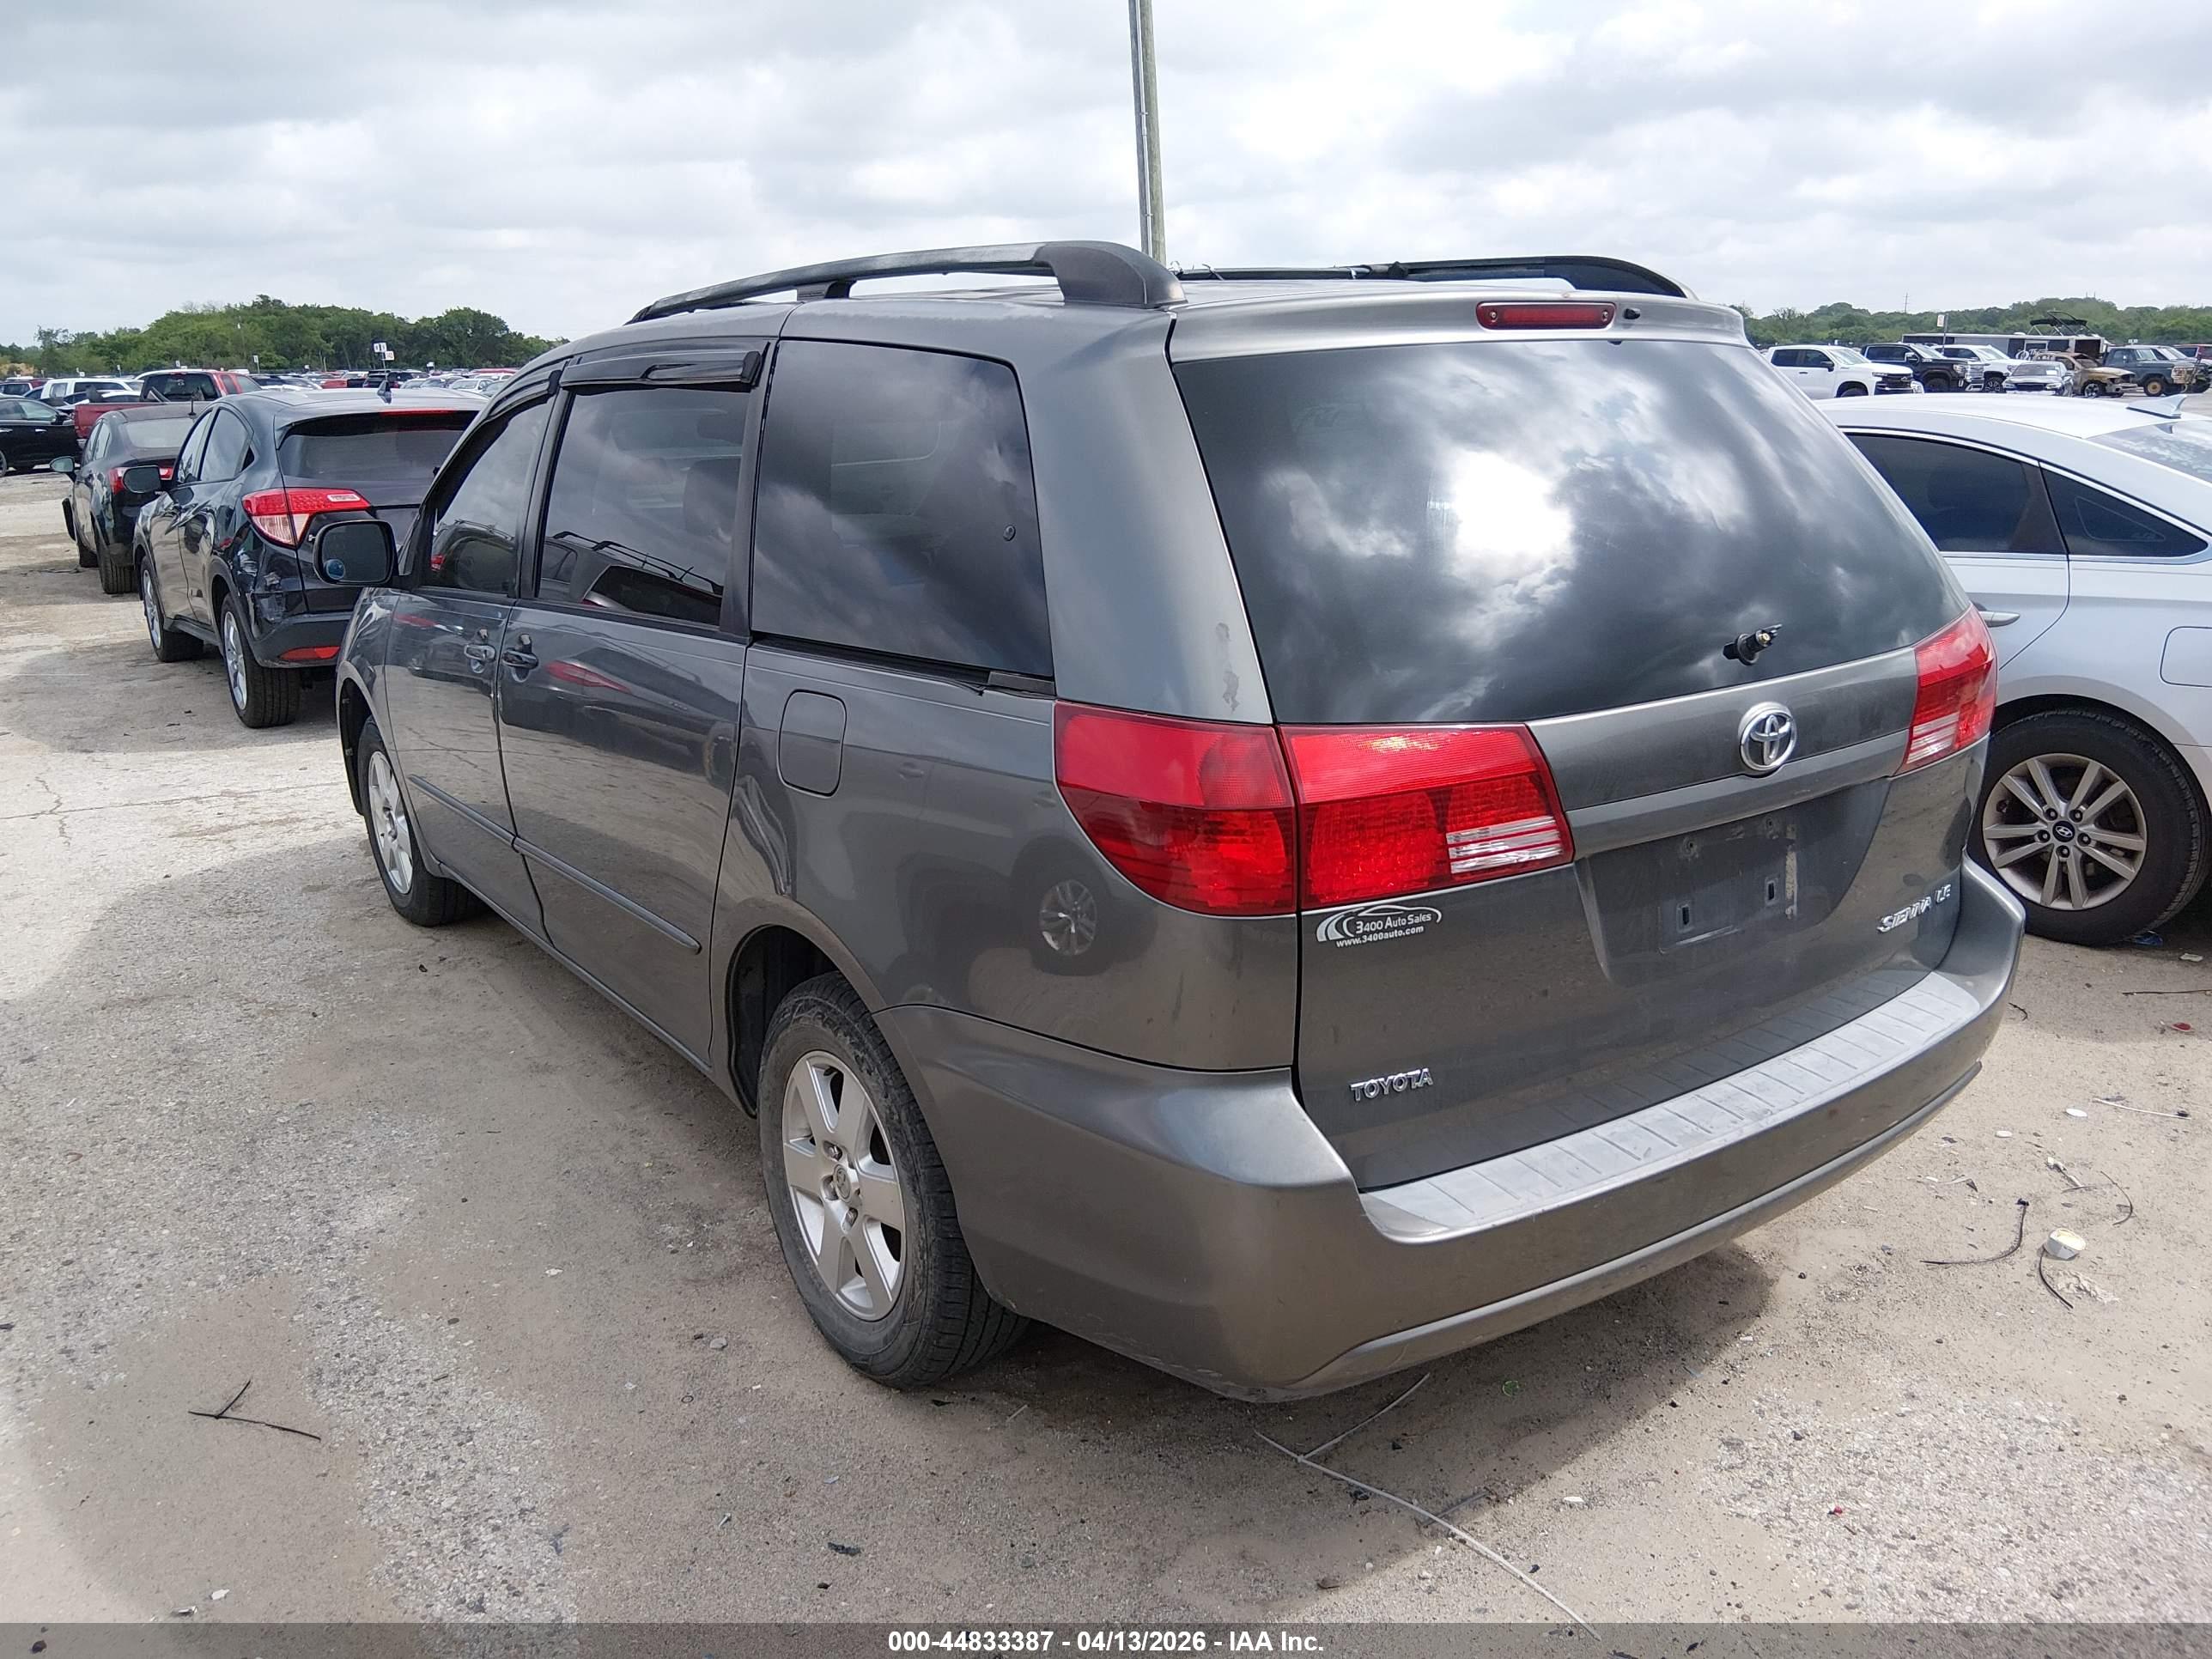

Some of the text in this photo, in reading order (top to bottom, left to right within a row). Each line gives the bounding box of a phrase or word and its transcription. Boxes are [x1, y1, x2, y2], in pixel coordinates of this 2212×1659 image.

[1877, 884, 1952, 933] SIENNA LE
[1336, 926, 1424, 947] www.3400auto.com
[1356, 913, 1431, 933] 3400 Auto Sales
[1350, 1068, 1433, 1102] TOYOTA
